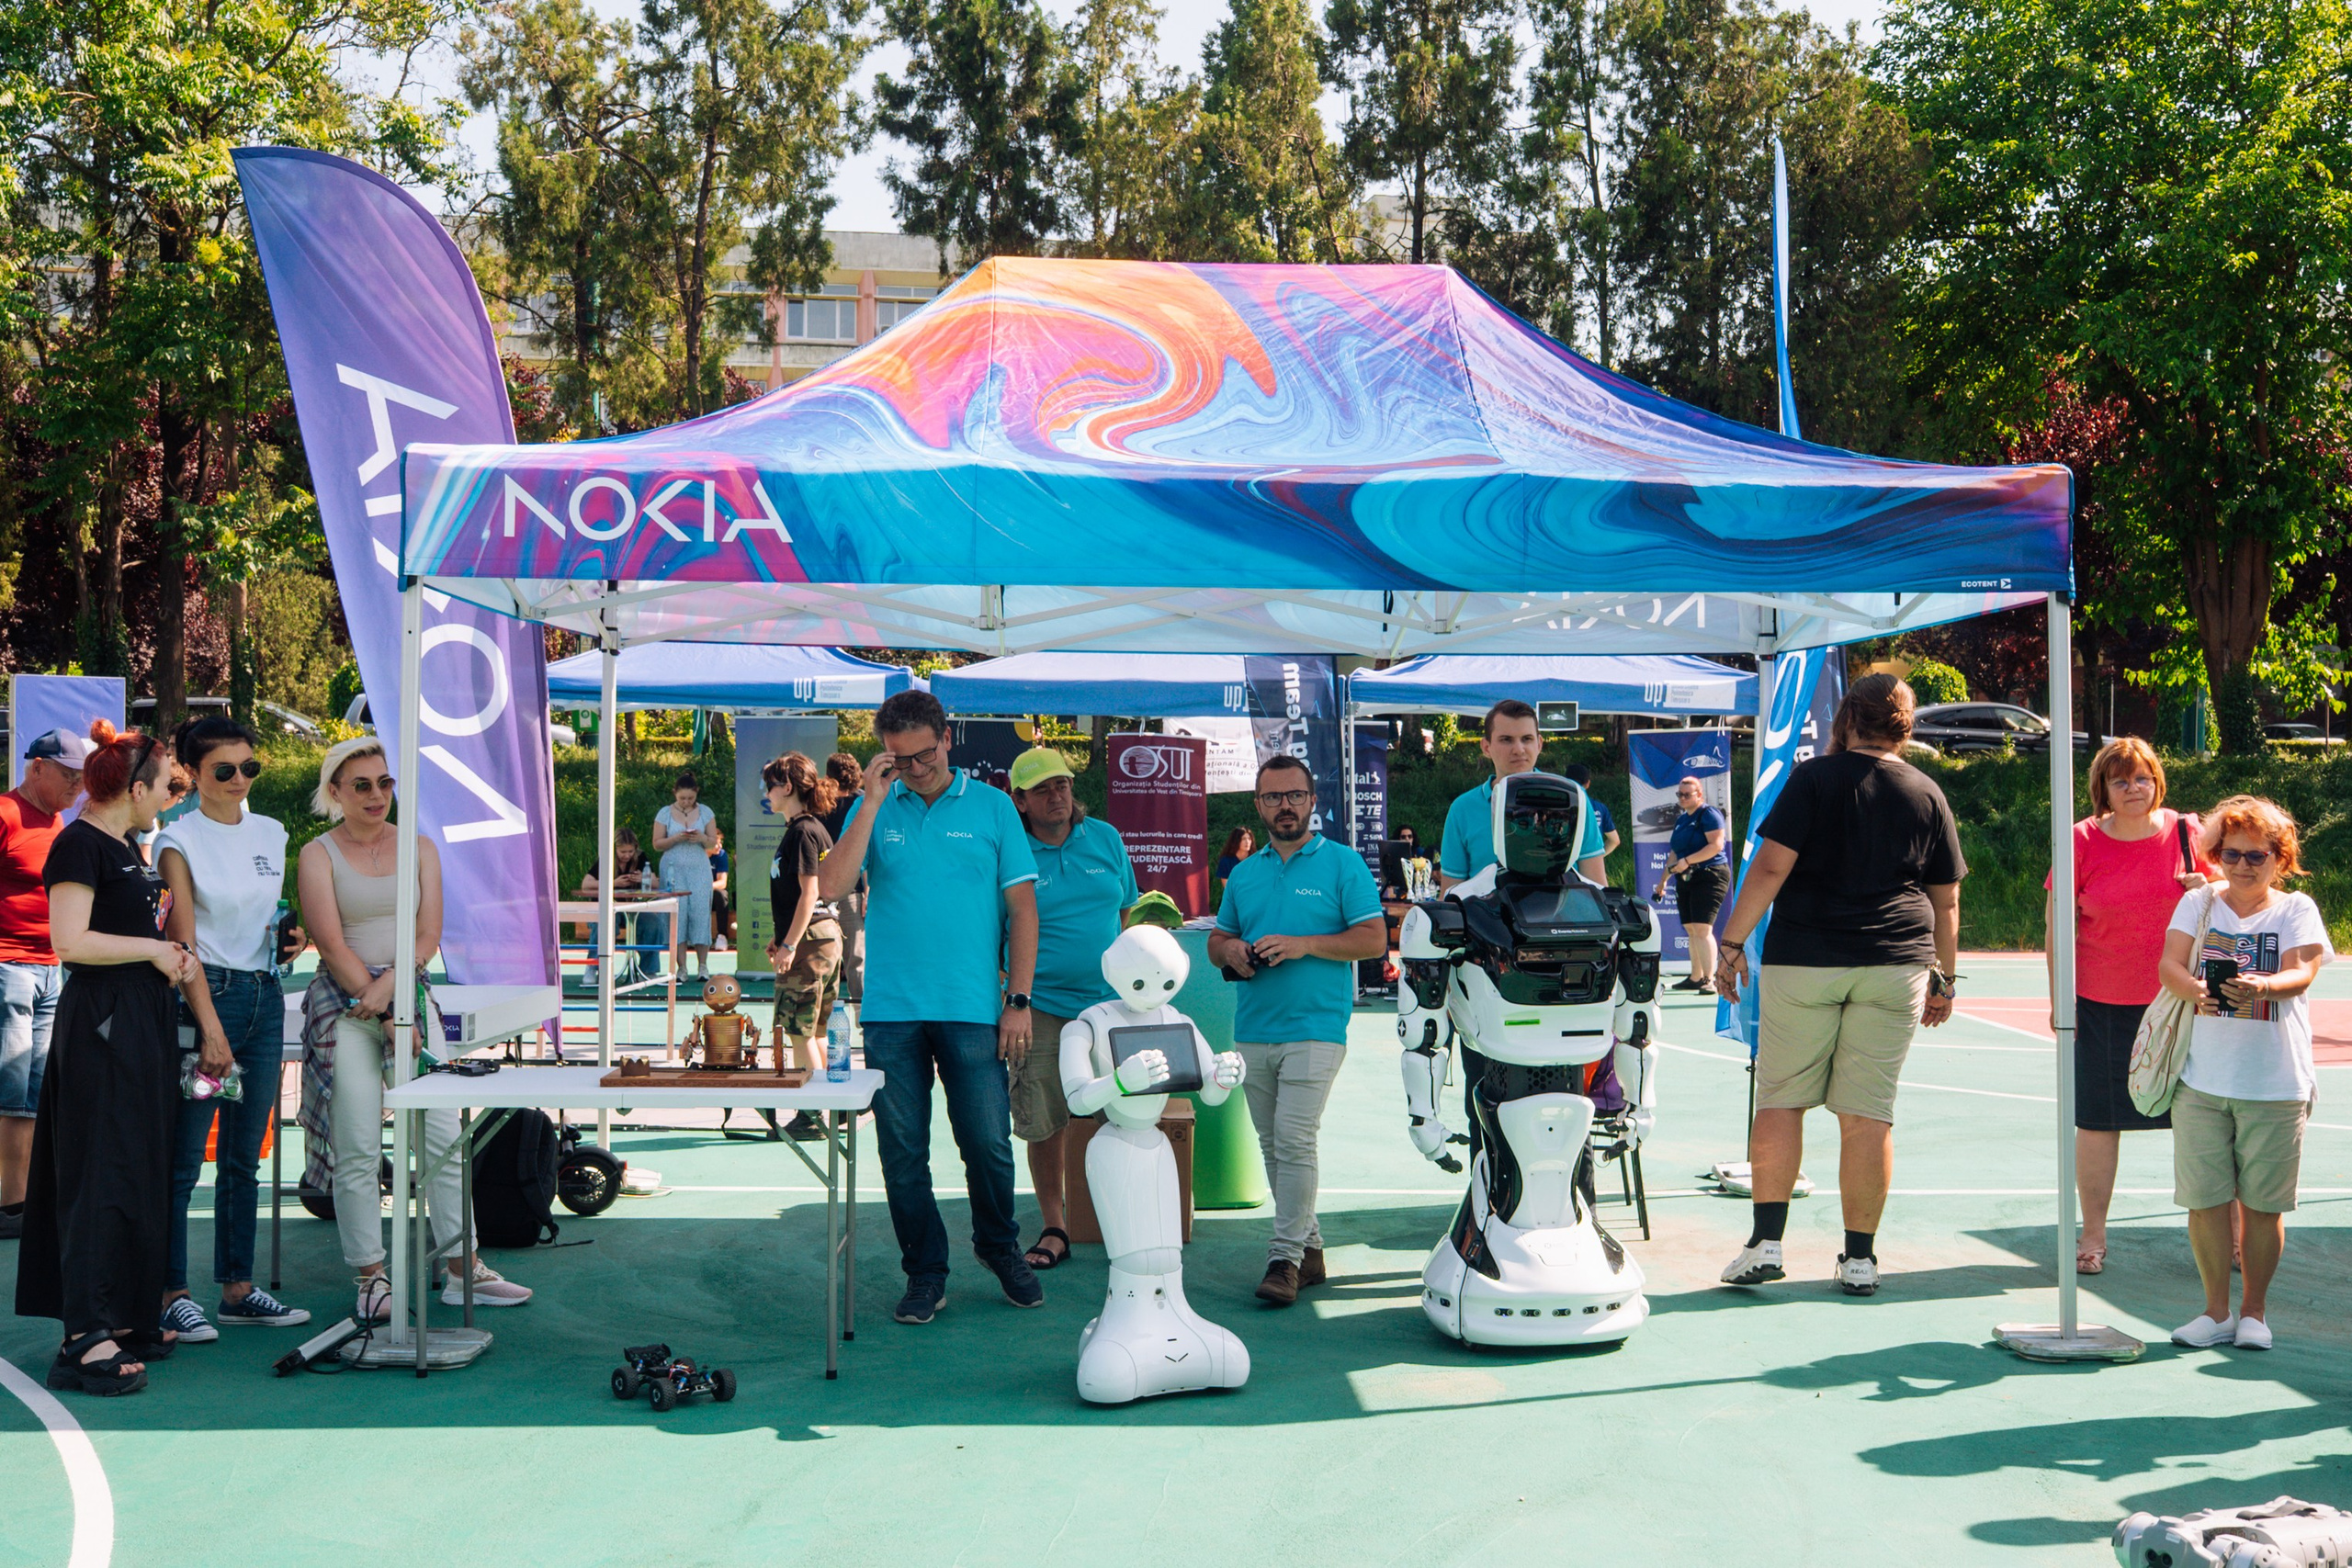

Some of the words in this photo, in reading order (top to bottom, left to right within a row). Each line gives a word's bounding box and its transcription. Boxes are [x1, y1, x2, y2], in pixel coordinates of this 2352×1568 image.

[503, 473, 793, 543] NOKIA
[1119, 745, 1194, 781] OSUT
[1128, 854, 1193, 864] TUDENȚEASCĂ
[1147, 864, 1168, 873] 24/7
[1295, 888, 1321, 897] NOKIA
